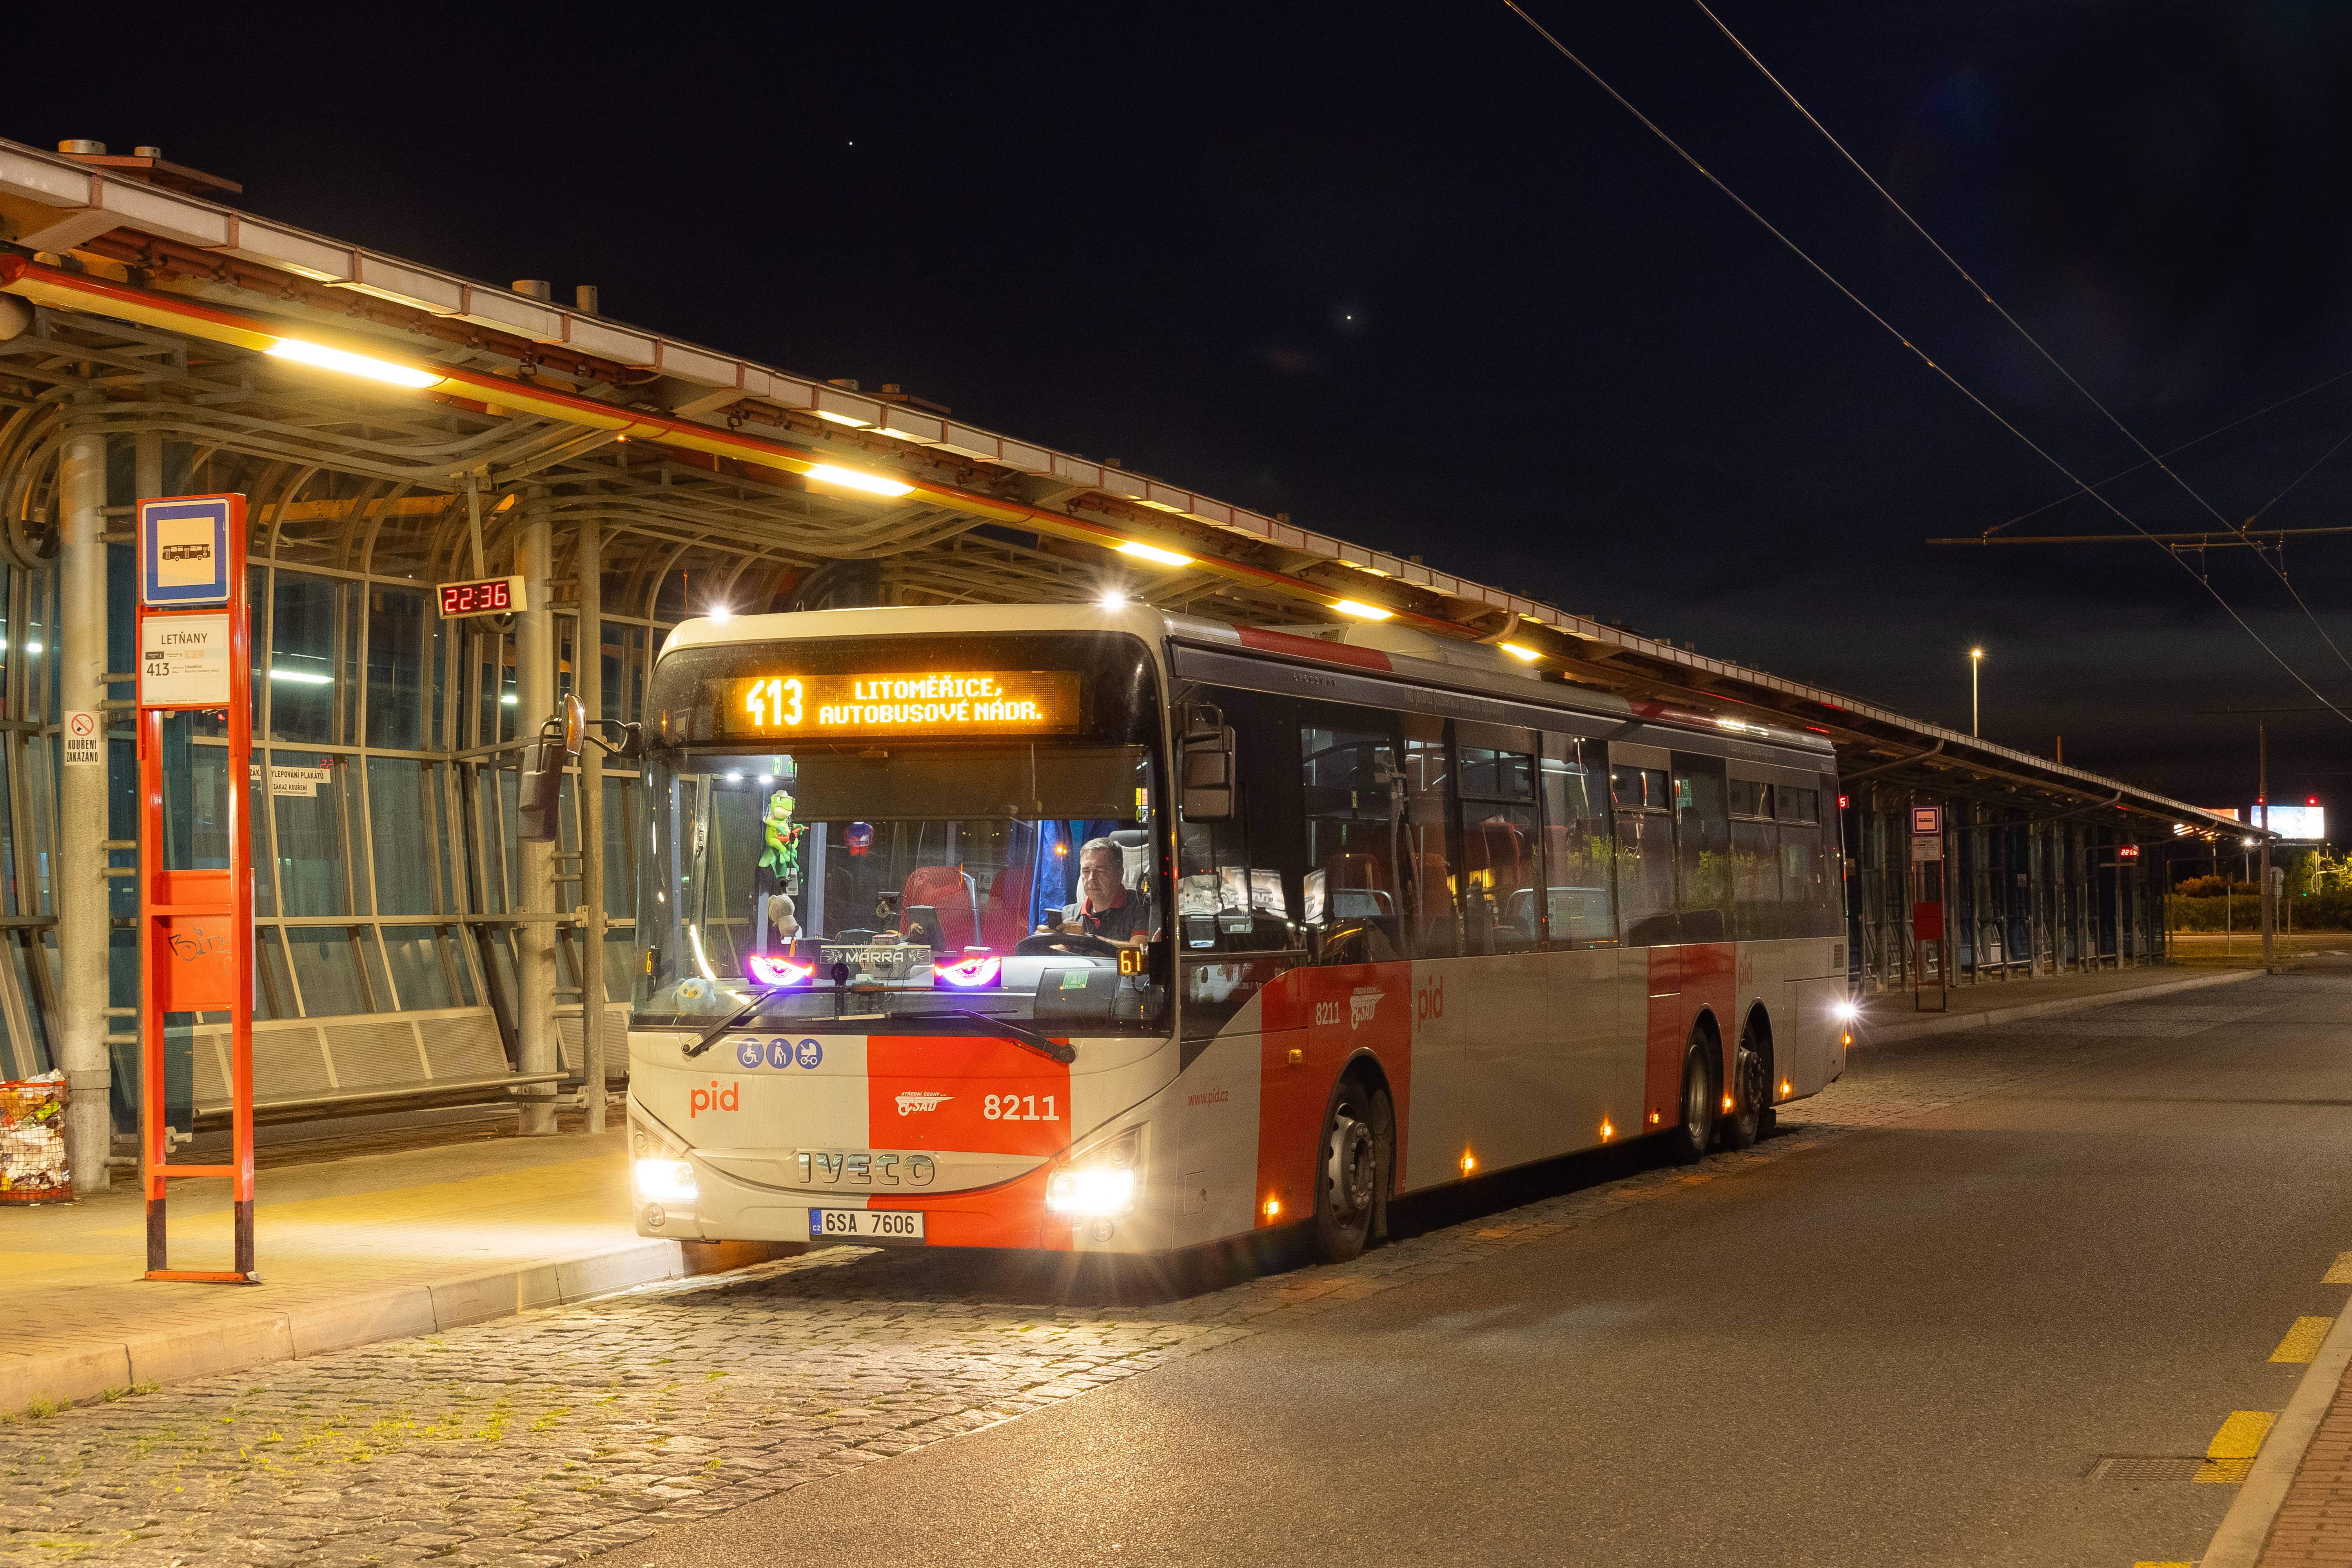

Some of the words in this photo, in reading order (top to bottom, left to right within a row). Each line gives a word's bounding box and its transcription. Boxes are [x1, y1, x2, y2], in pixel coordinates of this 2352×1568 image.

[445, 583, 506, 611] 22:36
[161, 631, 208, 644] LETŇANY
[147, 662, 169, 676] 413
[746, 679, 802, 725] 413
[855, 675, 1002, 699] LITOMĚŘICE,
[819, 699, 969, 724] AUTOBUSOVÉ
[975, 698, 1042, 720] NÁDR.
[68, 738, 97, 750] KOUŘENÍ
[67, 750, 98, 762] ZAKÁZÁNO
[249, 767, 261, 776] ZÁK
[271, 769, 299, 778] YLEPOVÁNÍ
[301, 770, 323, 779] PLAKÁTŮ
[1840, 798, 1845, 807] 5
[846, 952, 904, 962] MARRA
[1121, 950, 1140, 973] 61
[1739, 953, 1752, 995] pid
[1316, 1001, 1340, 1025] 8211
[1418, 975, 1443, 1033] pid
[691, 1080, 739, 1118] pid
[905, 1097, 937, 1112] ČSAD
[984, 1094, 1059, 1121] 8211
[1188, 1087, 1229, 1108] www.pid.cz
[799, 1153, 935, 1186] IVECO
[826, 1213, 857, 1232] 6SA
[871, 1214, 914, 1234] 7606
